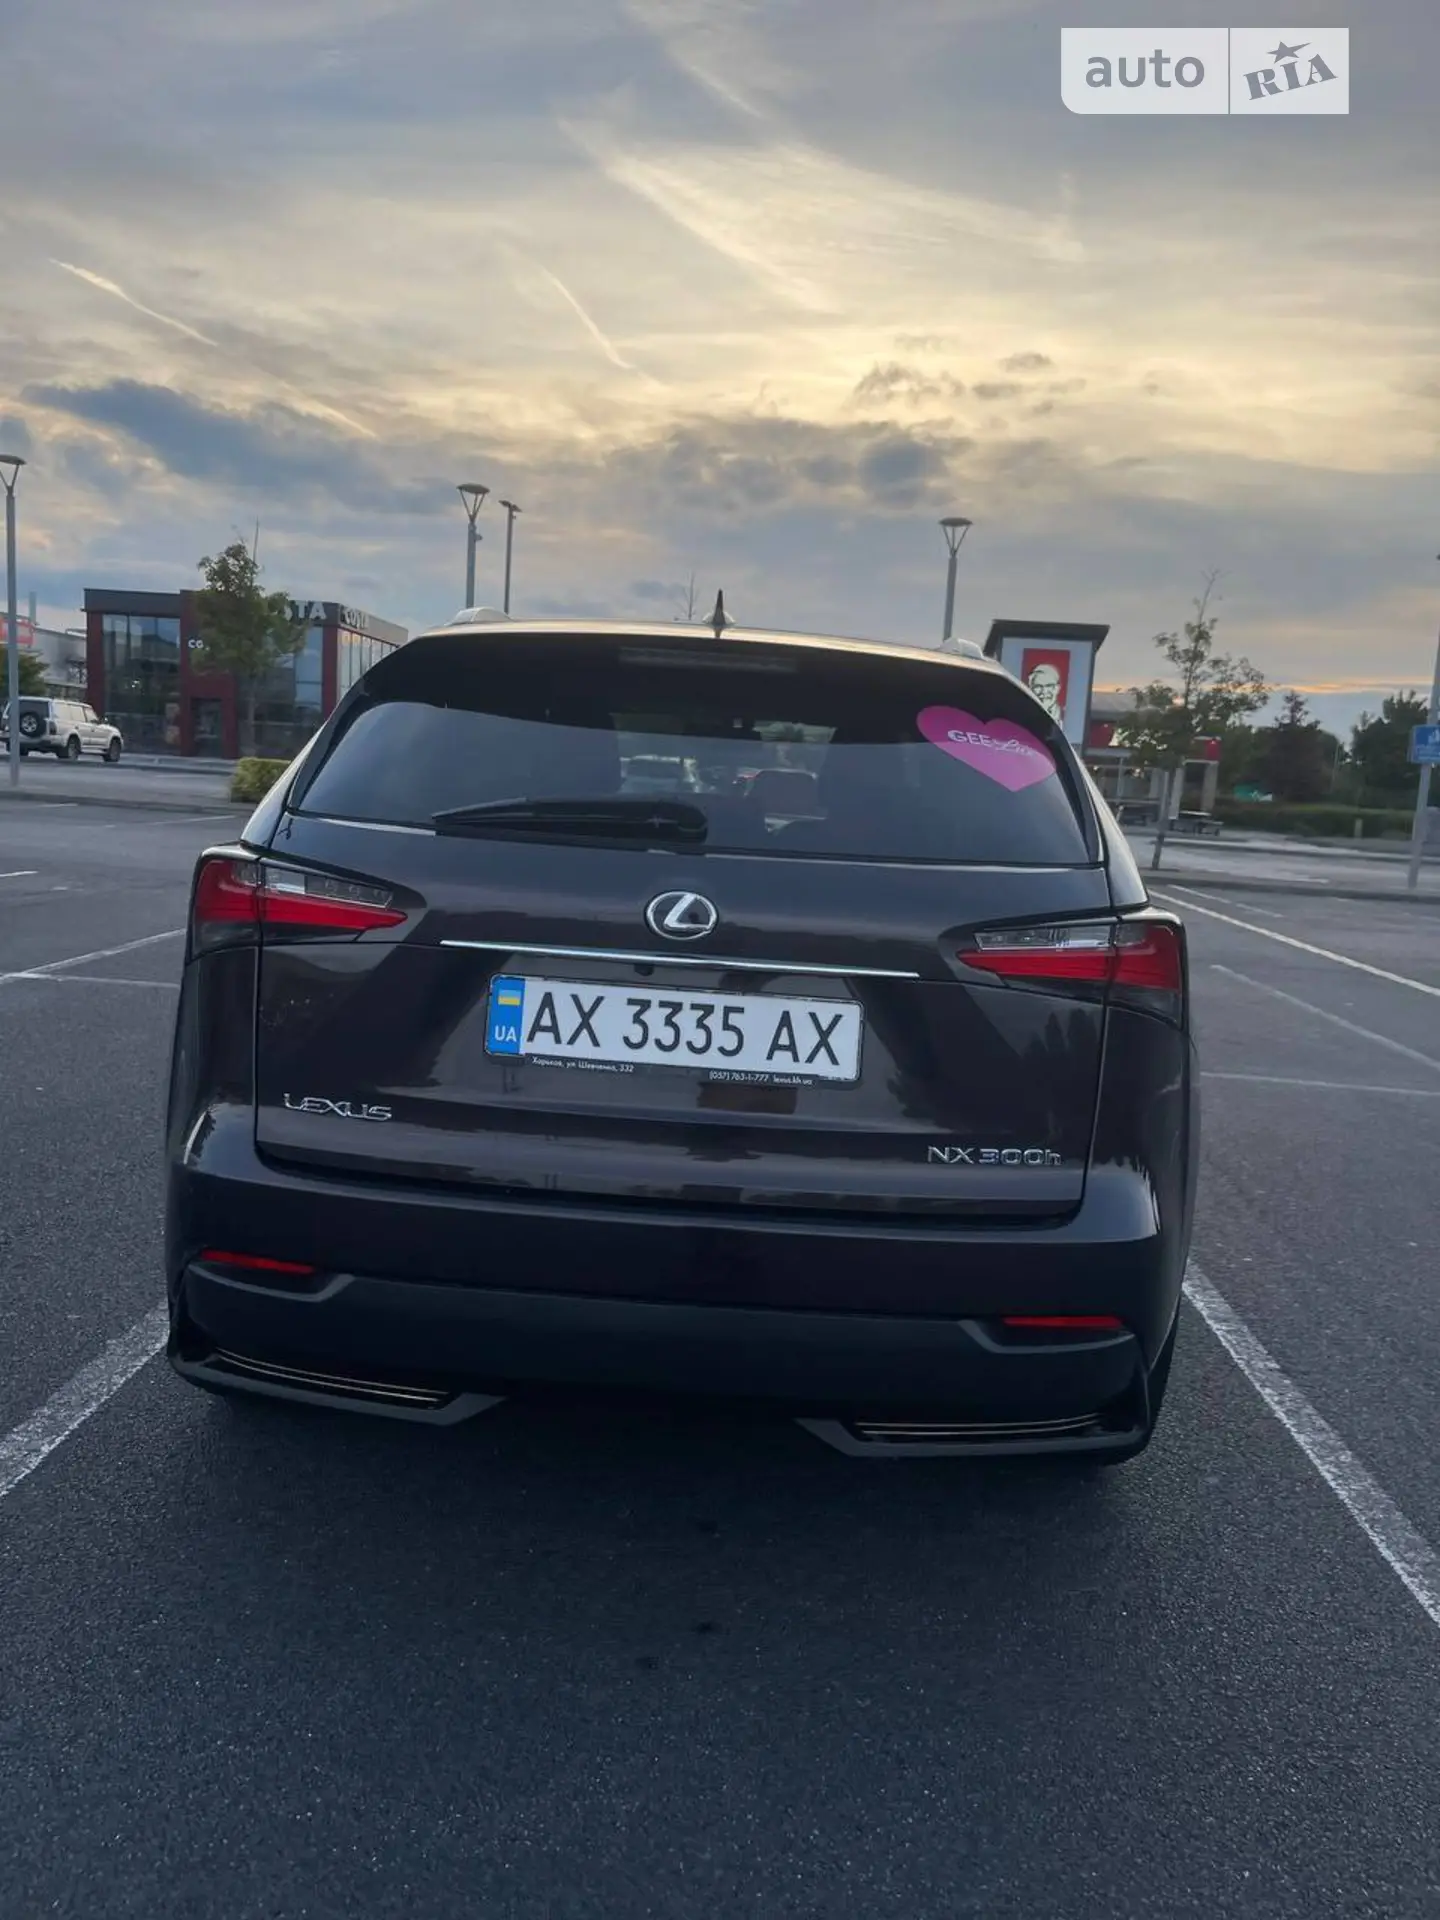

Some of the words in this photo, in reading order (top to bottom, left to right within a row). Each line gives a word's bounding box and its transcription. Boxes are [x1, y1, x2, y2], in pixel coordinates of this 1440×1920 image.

[494, 1025, 517, 1042] UA
[526, 991, 605, 1047] AX
[622, 998, 745, 1057] 3335
[765, 1010, 843, 1066] AX
[284, 1093, 392, 1121] LEXUS
[928, 1146, 974, 1165] NX
[979, 1148, 1062, 1166] 300h
